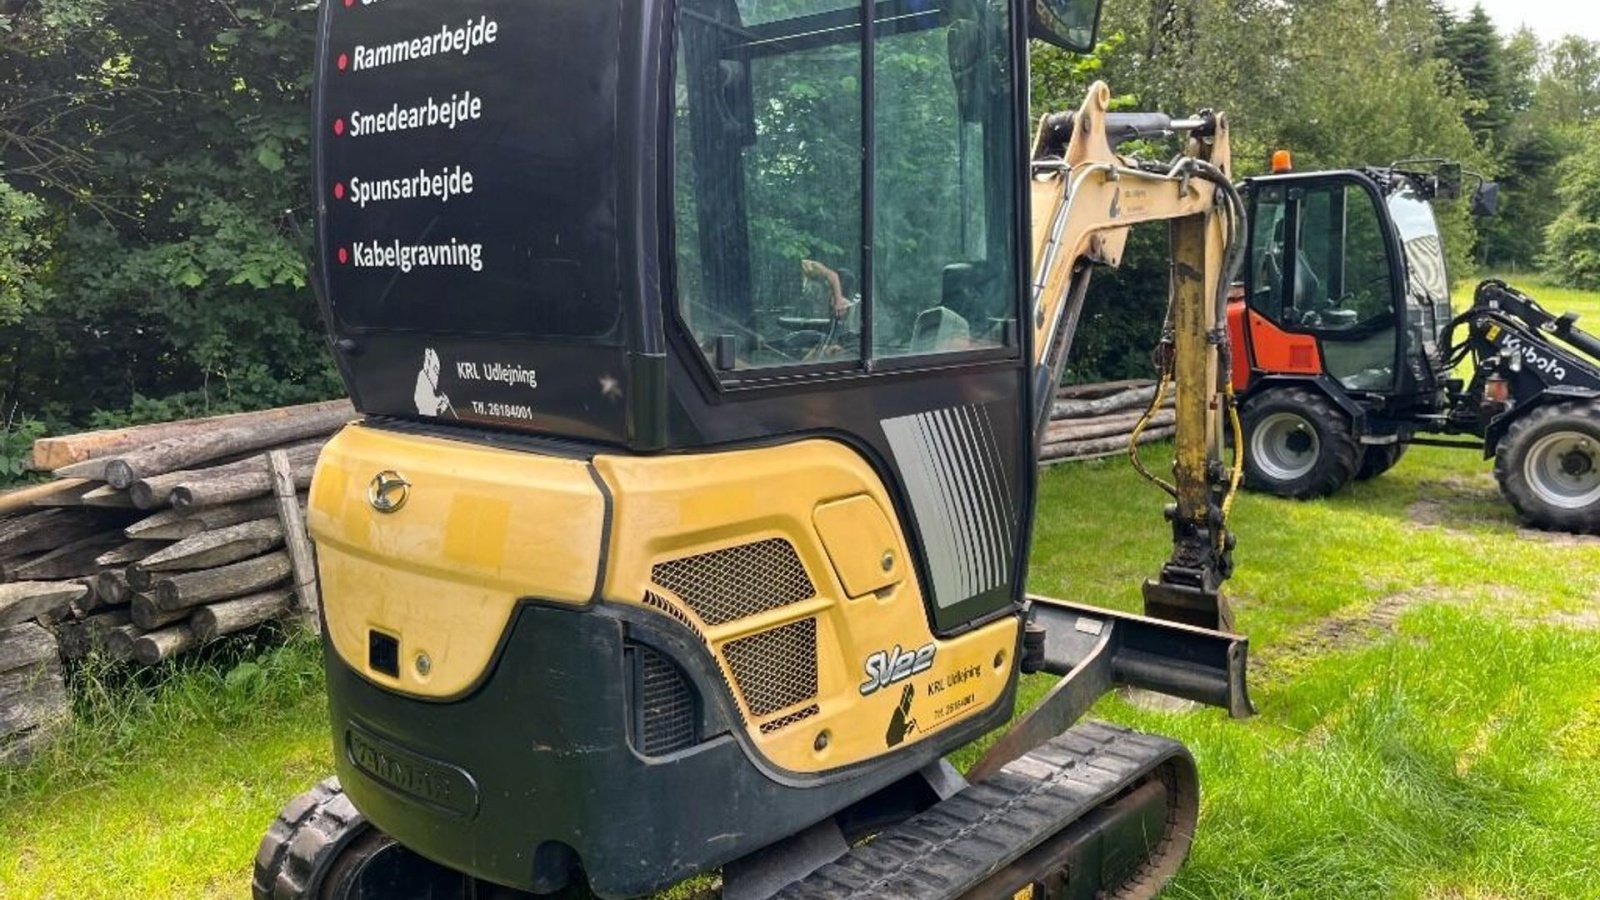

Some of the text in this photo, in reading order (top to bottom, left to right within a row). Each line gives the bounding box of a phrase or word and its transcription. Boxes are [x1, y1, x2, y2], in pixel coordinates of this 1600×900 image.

[353, 16, 498, 71] Rammearbejde
[350, 91, 482, 137] Smedearbejde
[350, 165, 473, 207] Spunsarbejde
[353, 238, 483, 272] Kabelgravning
[456, 362, 538, 388] KRL Udlejning
[1501, 333, 1566, 380] Kbota
[488, 403, 533, 420] 26184001
[859, 642, 937, 696] SV22
[927, 678, 945, 697] KRL
